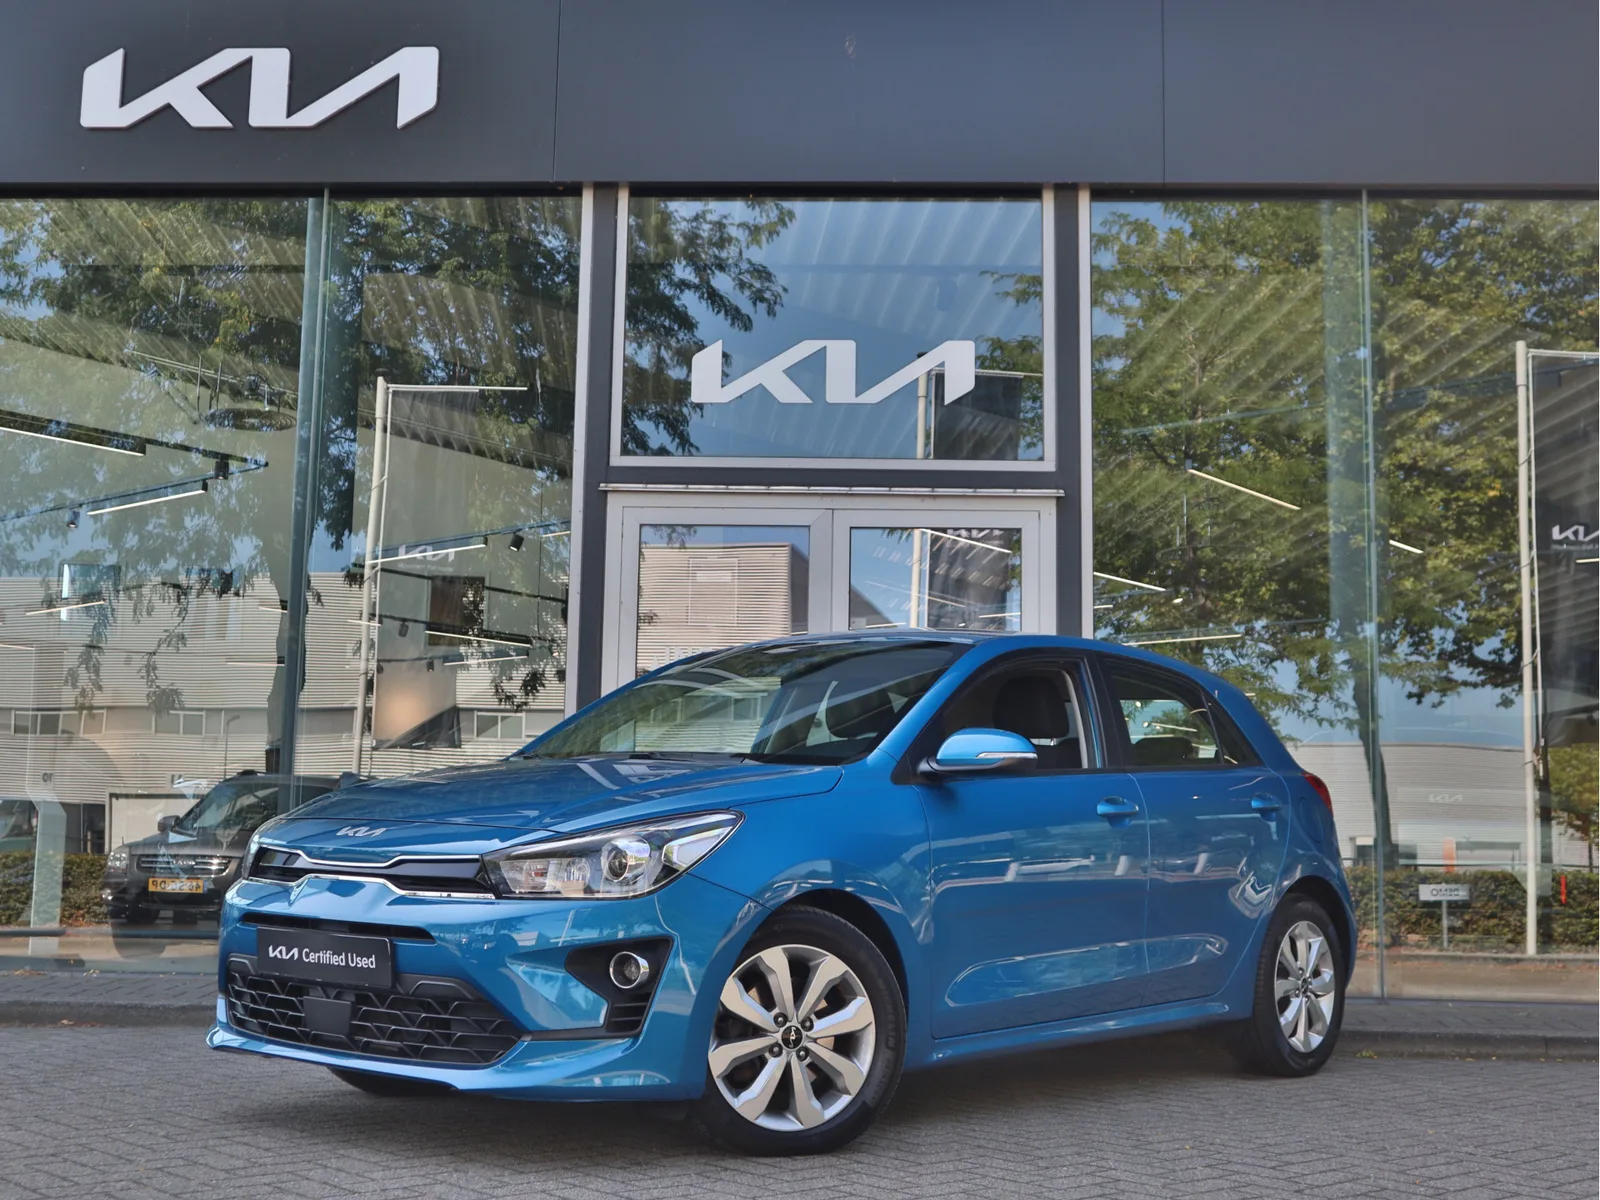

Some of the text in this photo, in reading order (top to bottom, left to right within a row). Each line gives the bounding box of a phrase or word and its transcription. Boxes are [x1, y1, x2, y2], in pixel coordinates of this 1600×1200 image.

[80, 45, 440, 130] KIA
[691, 339, 976, 405] KIA
[336, 825, 387, 838] KIA
[268, 944, 376, 969] KIA Certified Used
